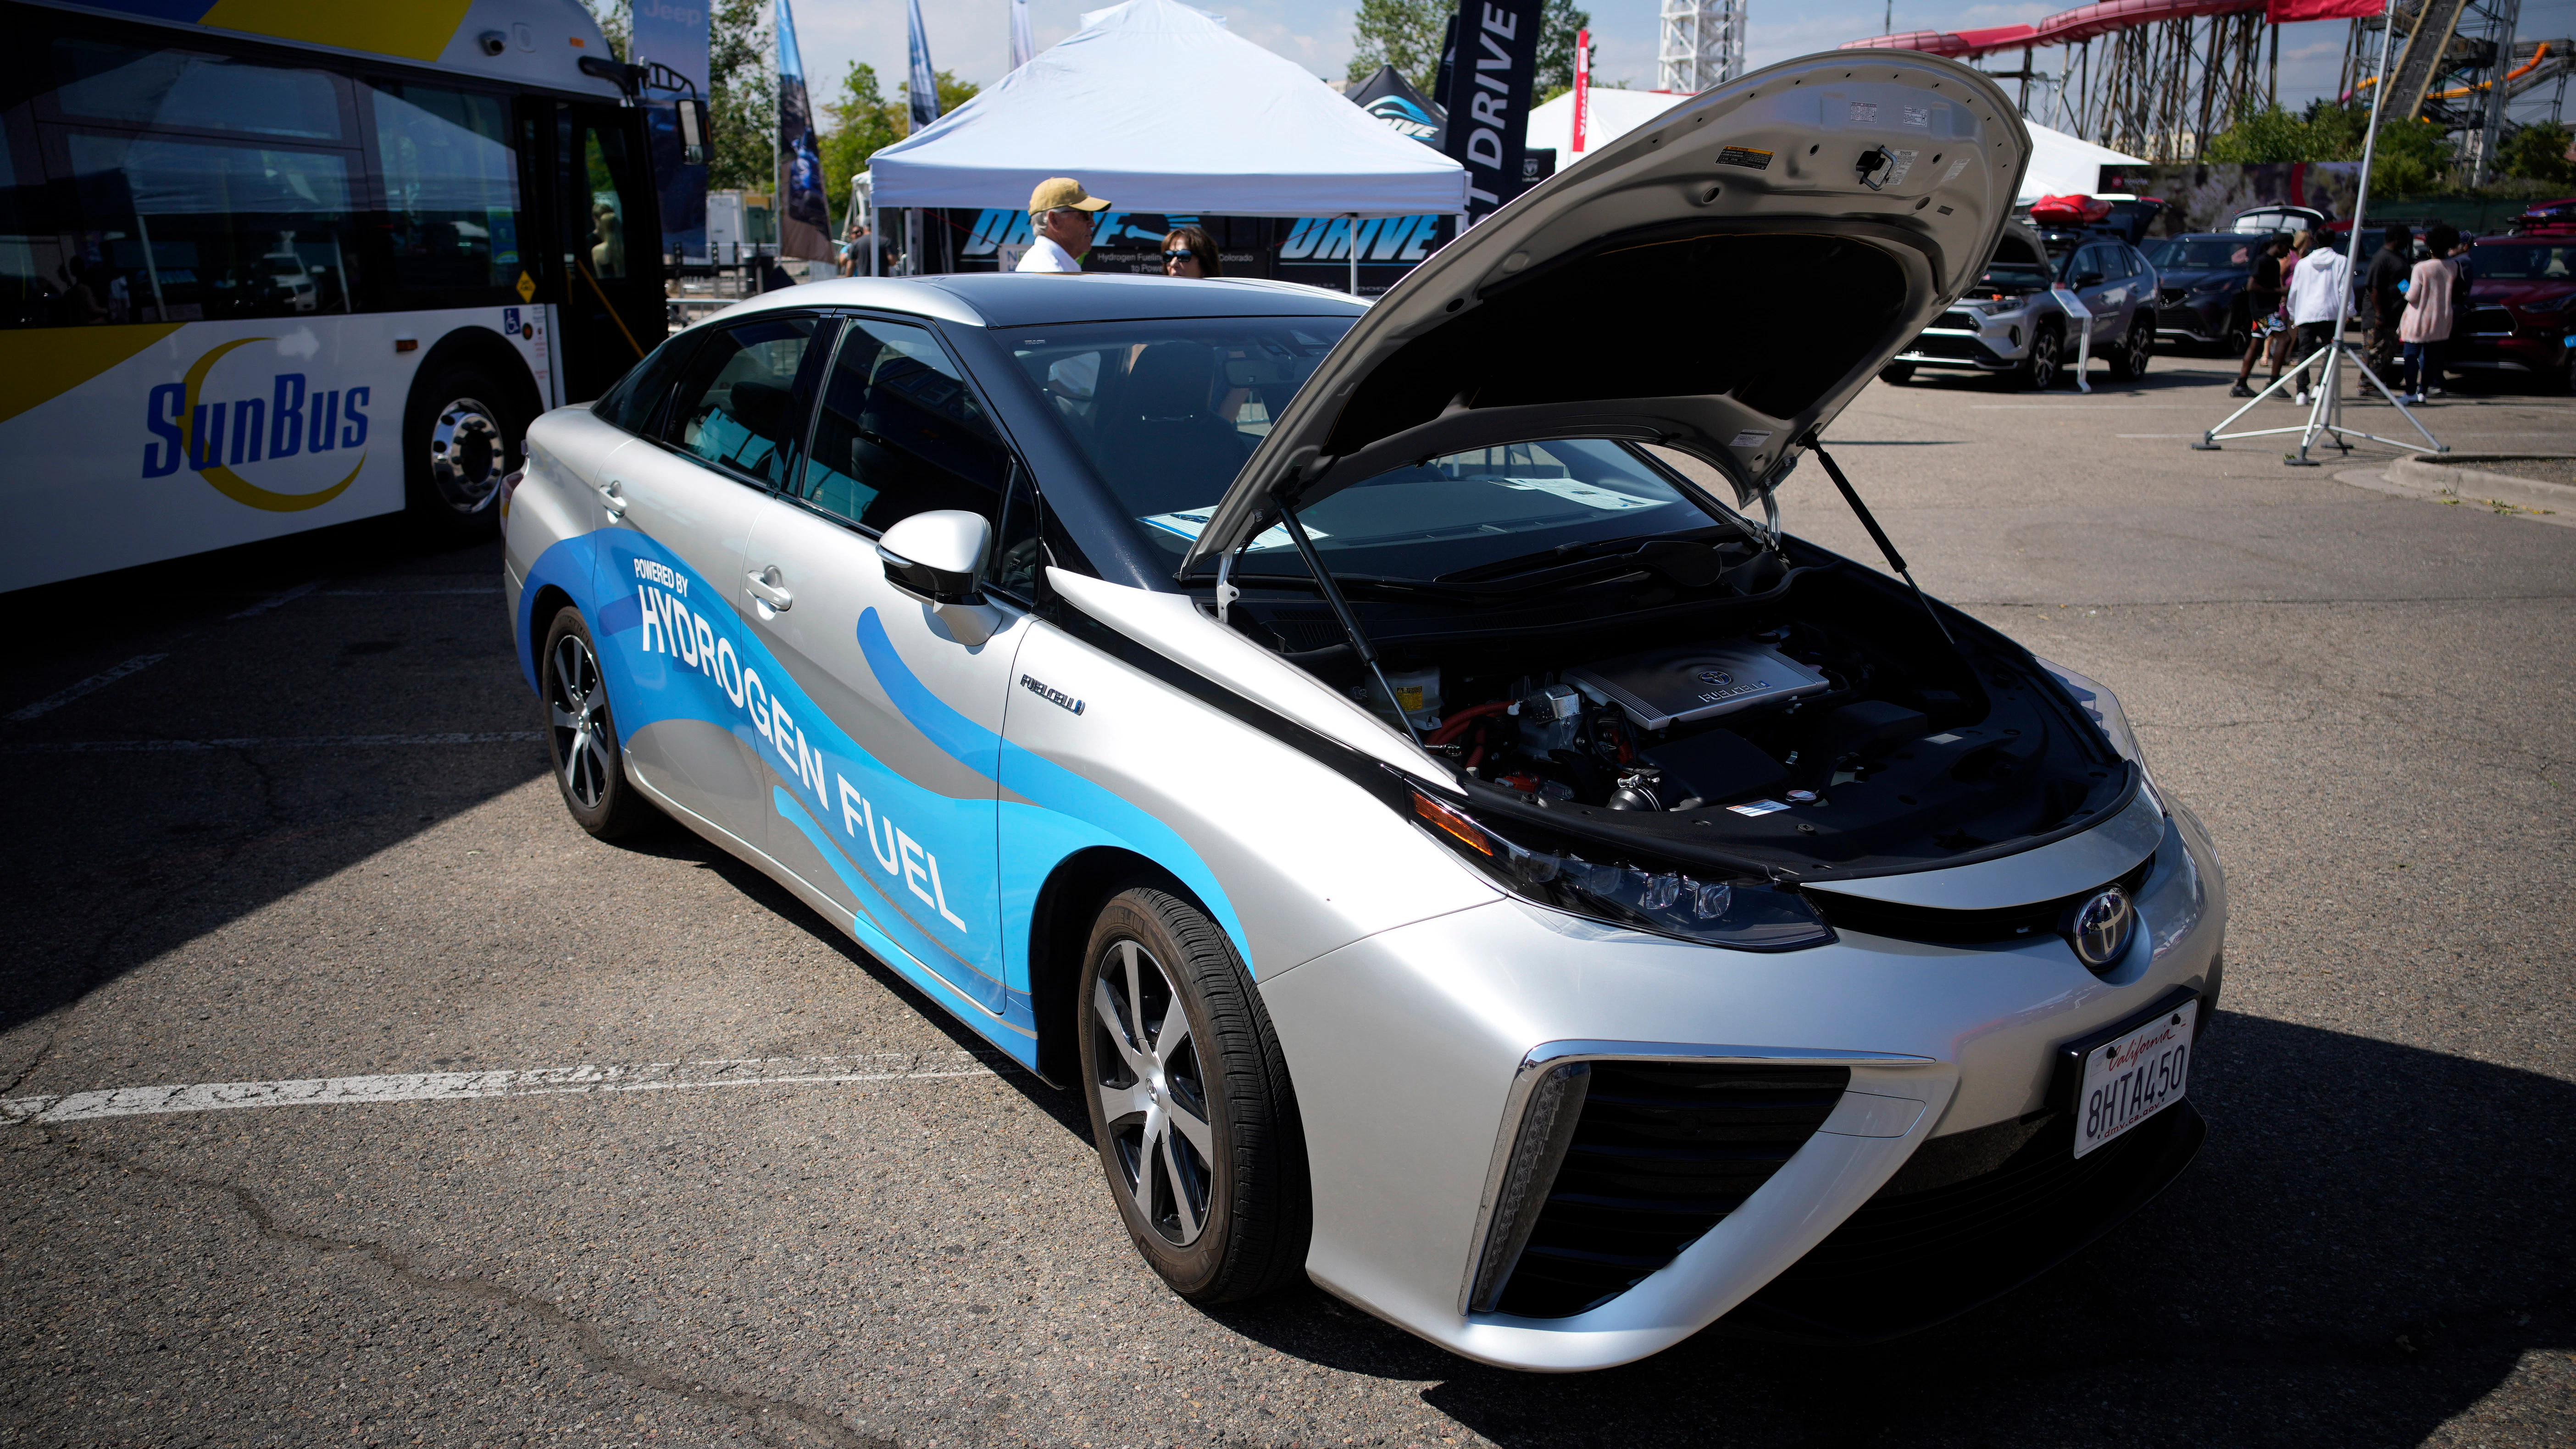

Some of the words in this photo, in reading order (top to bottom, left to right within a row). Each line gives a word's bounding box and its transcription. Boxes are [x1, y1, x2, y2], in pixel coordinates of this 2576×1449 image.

[643, 0, 703, 27] Jeep
[1467, 1, 1518, 170] DRIVE
[1098, 253, 1136, 263] Hydrogen
[1137, 253, 1163, 261] Fuelin
[1219, 253, 1254, 262] Colorado
[1279, 214, 1438, 260] DRIVE
[1140, 263, 1164, 272] Powe
[142, 373, 371, 479] SunBus
[633, 558, 674, 588] POWERED
[676, 572, 688, 595] BY
[638, 585, 829, 812] HYDROGEN
[836, 772, 967, 934] FUEL
[2109, 1025, 2176, 1071] California
[2087, 1044, 2185, 1138] 8HTA450
[2104, 1102, 2160, 1138] dmv.ca.gov
